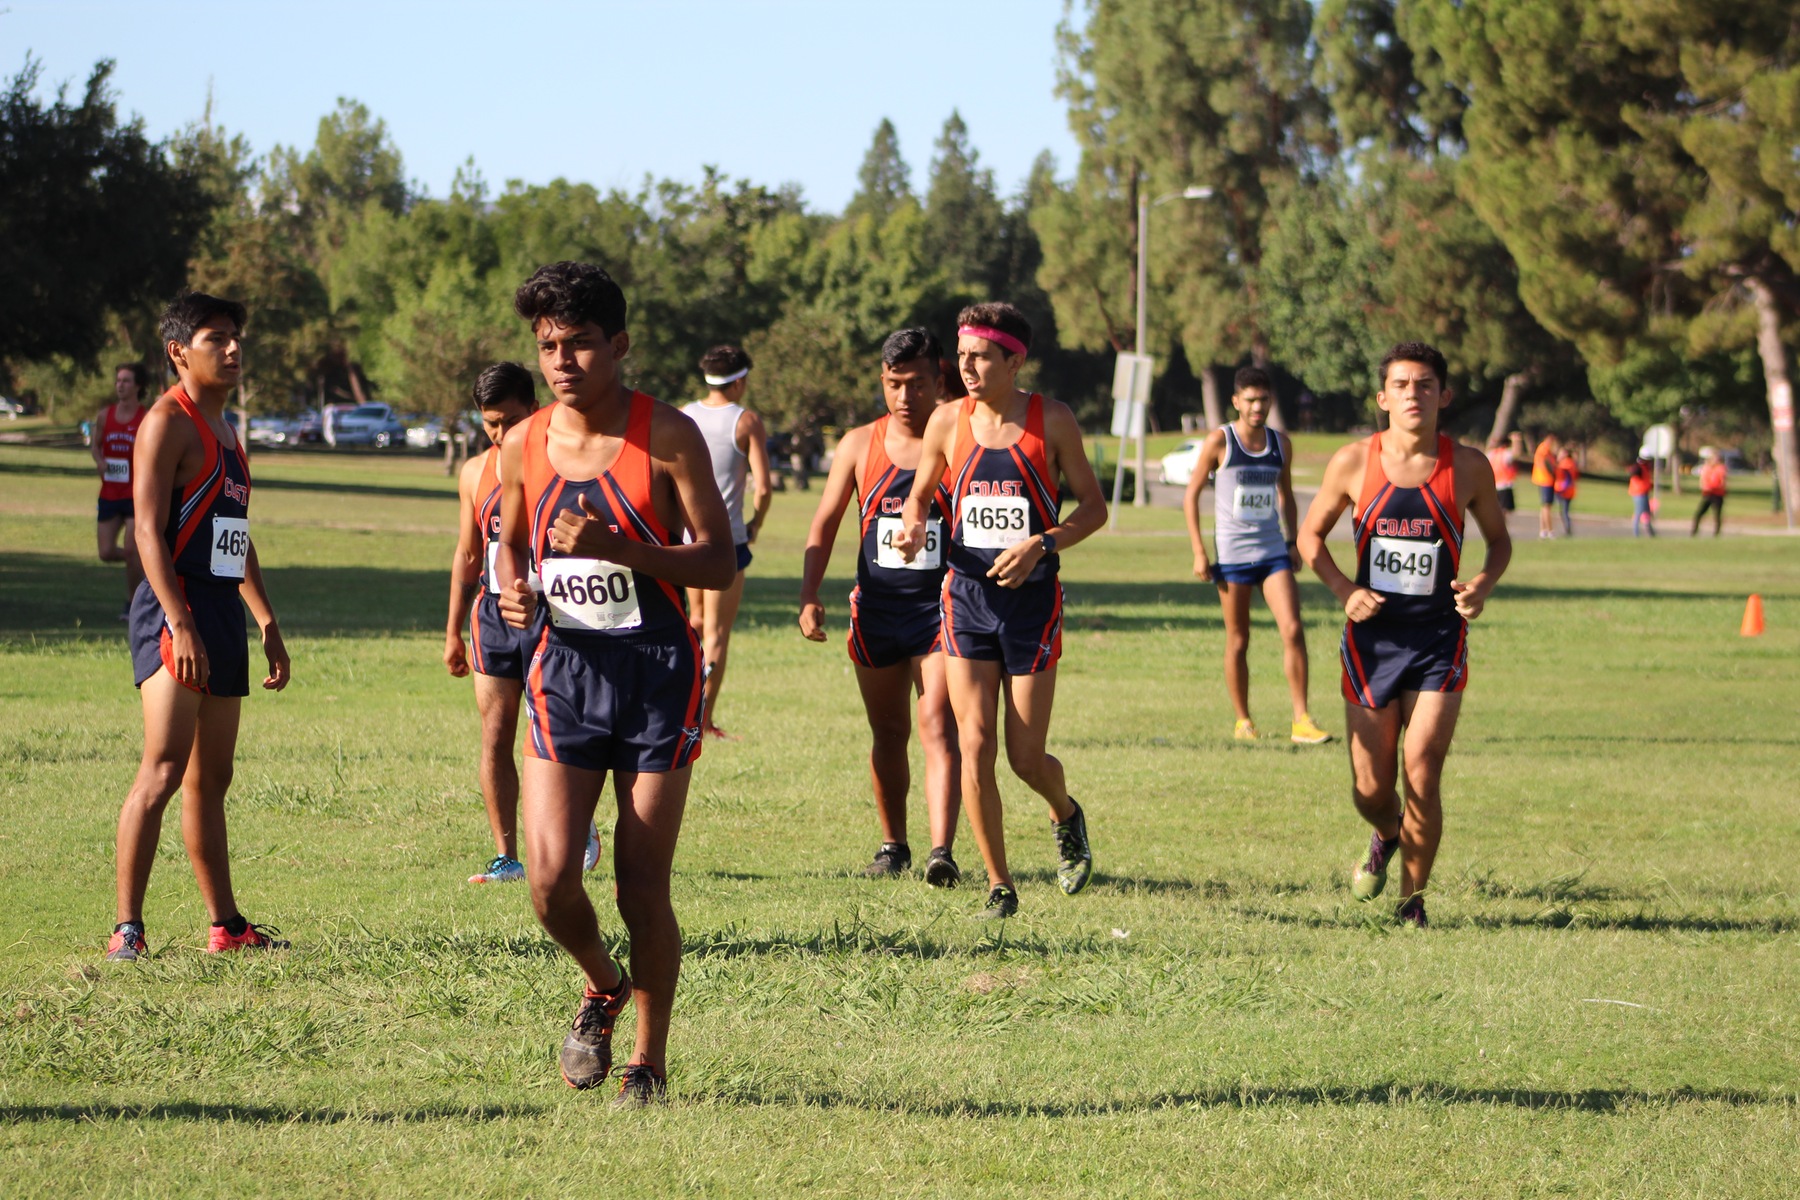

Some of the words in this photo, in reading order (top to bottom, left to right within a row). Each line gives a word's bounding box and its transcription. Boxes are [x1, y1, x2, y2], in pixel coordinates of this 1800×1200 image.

[969, 480, 1022, 497] COAST
[966, 506, 1024, 530] 4653
[1376, 518, 1433, 537] COAST
[216, 529, 250, 557] 465
[882, 529, 937, 552] 46
[1373, 549, 1433, 577] 4649
[550, 571, 629, 606] 4660
